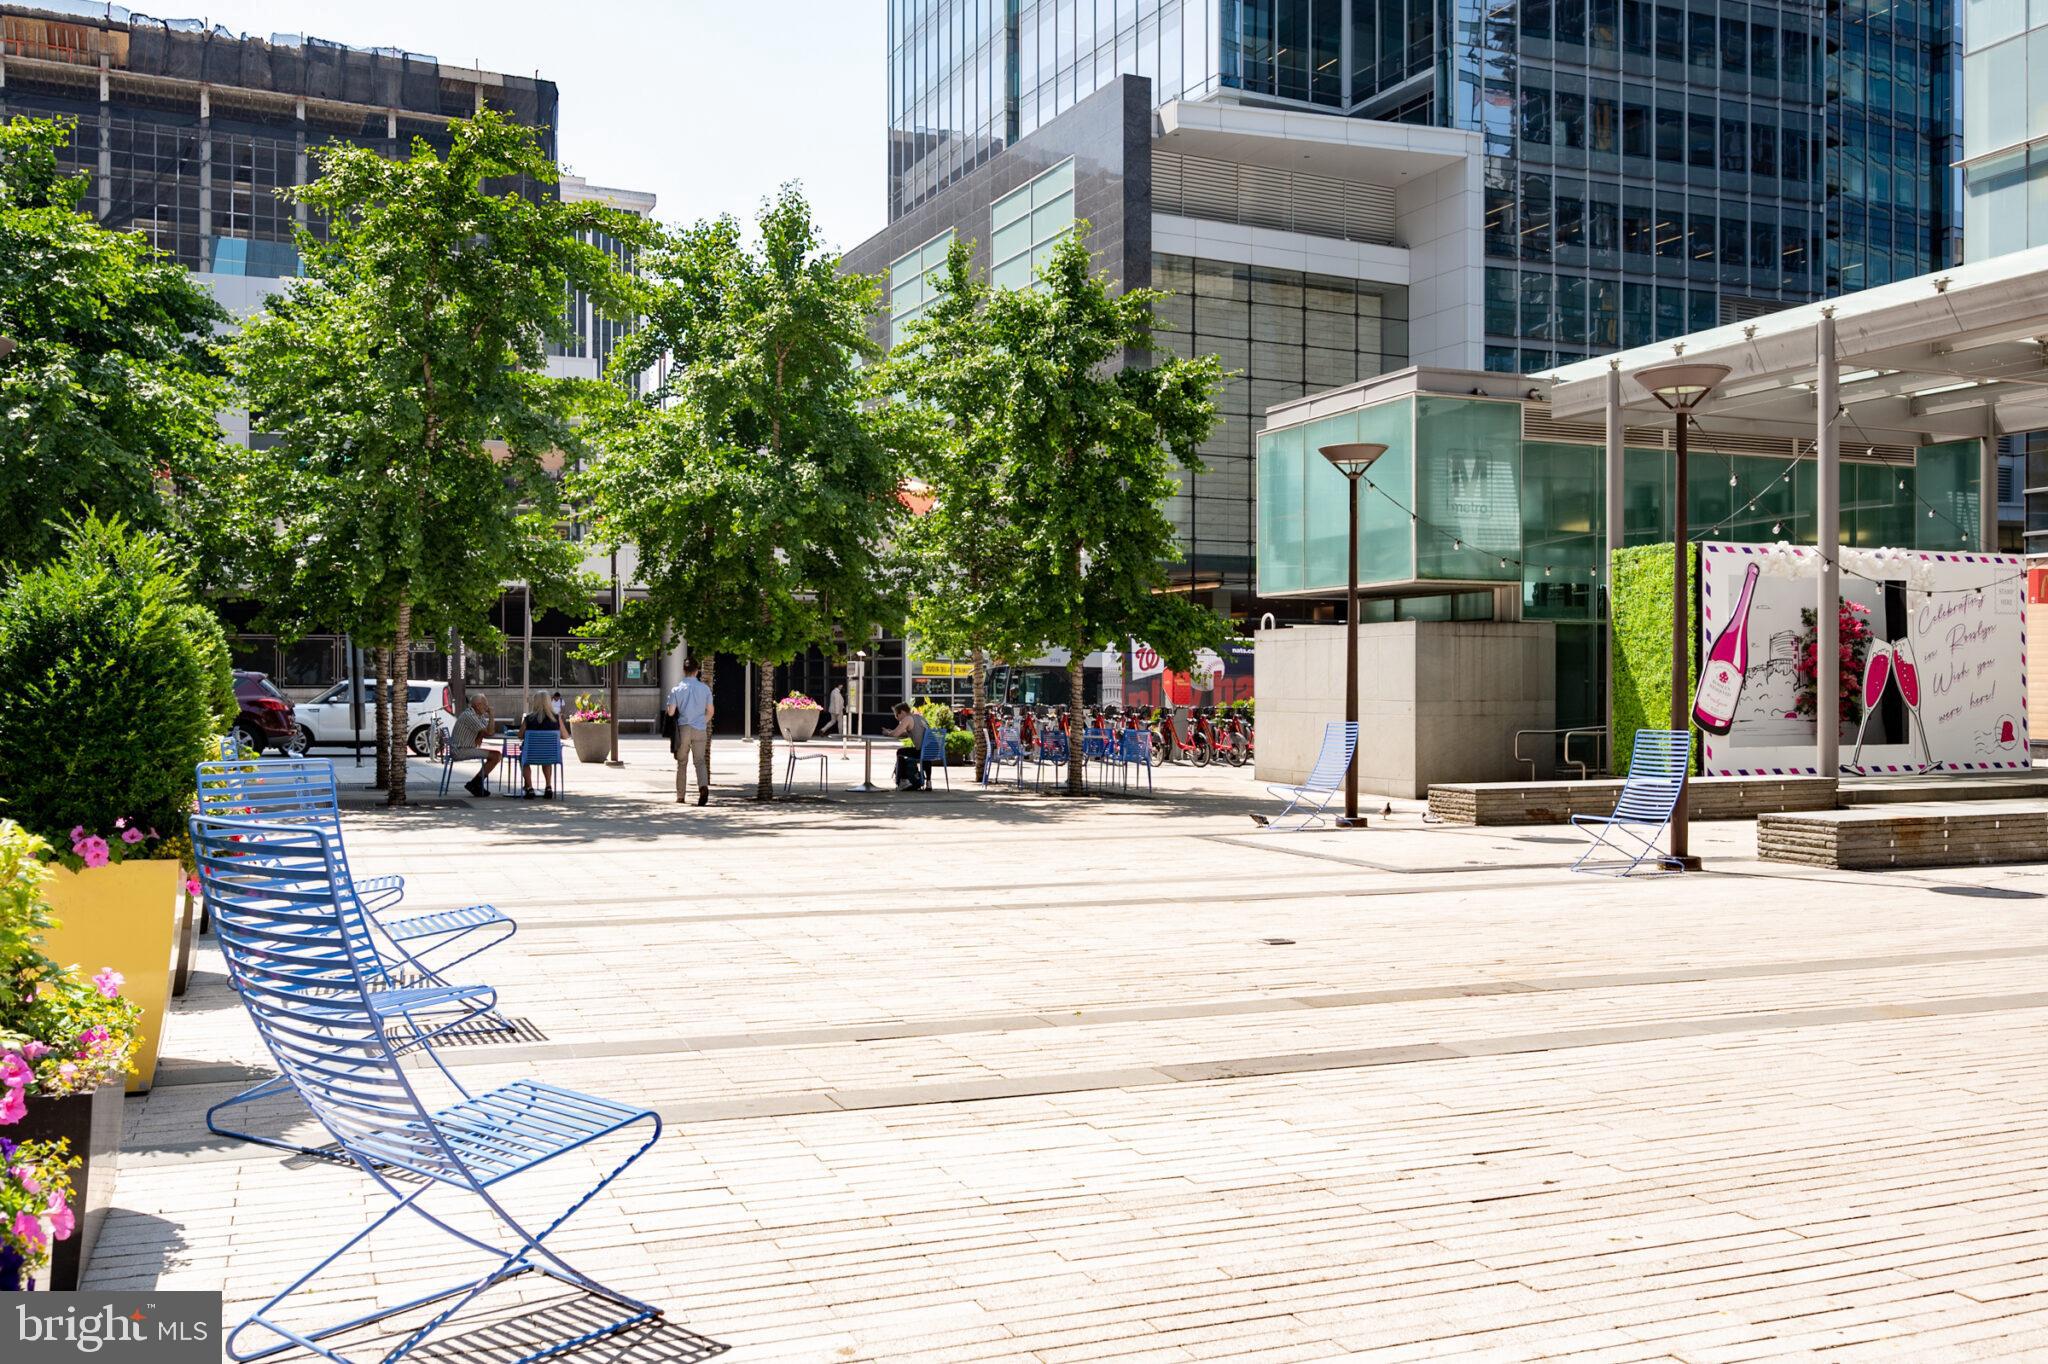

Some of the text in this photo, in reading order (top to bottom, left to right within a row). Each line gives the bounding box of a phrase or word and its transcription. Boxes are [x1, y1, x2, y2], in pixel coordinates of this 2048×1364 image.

[1451, 453, 1487, 499] M
[1451, 502, 1488, 514] metro
[1919, 594, 1986, 634] Celebrating
[1946, 620, 1998, 654] Rosslyn
[1933, 658, 1996, 696] Wish you
[1938, 680, 1996, 724] were here!
